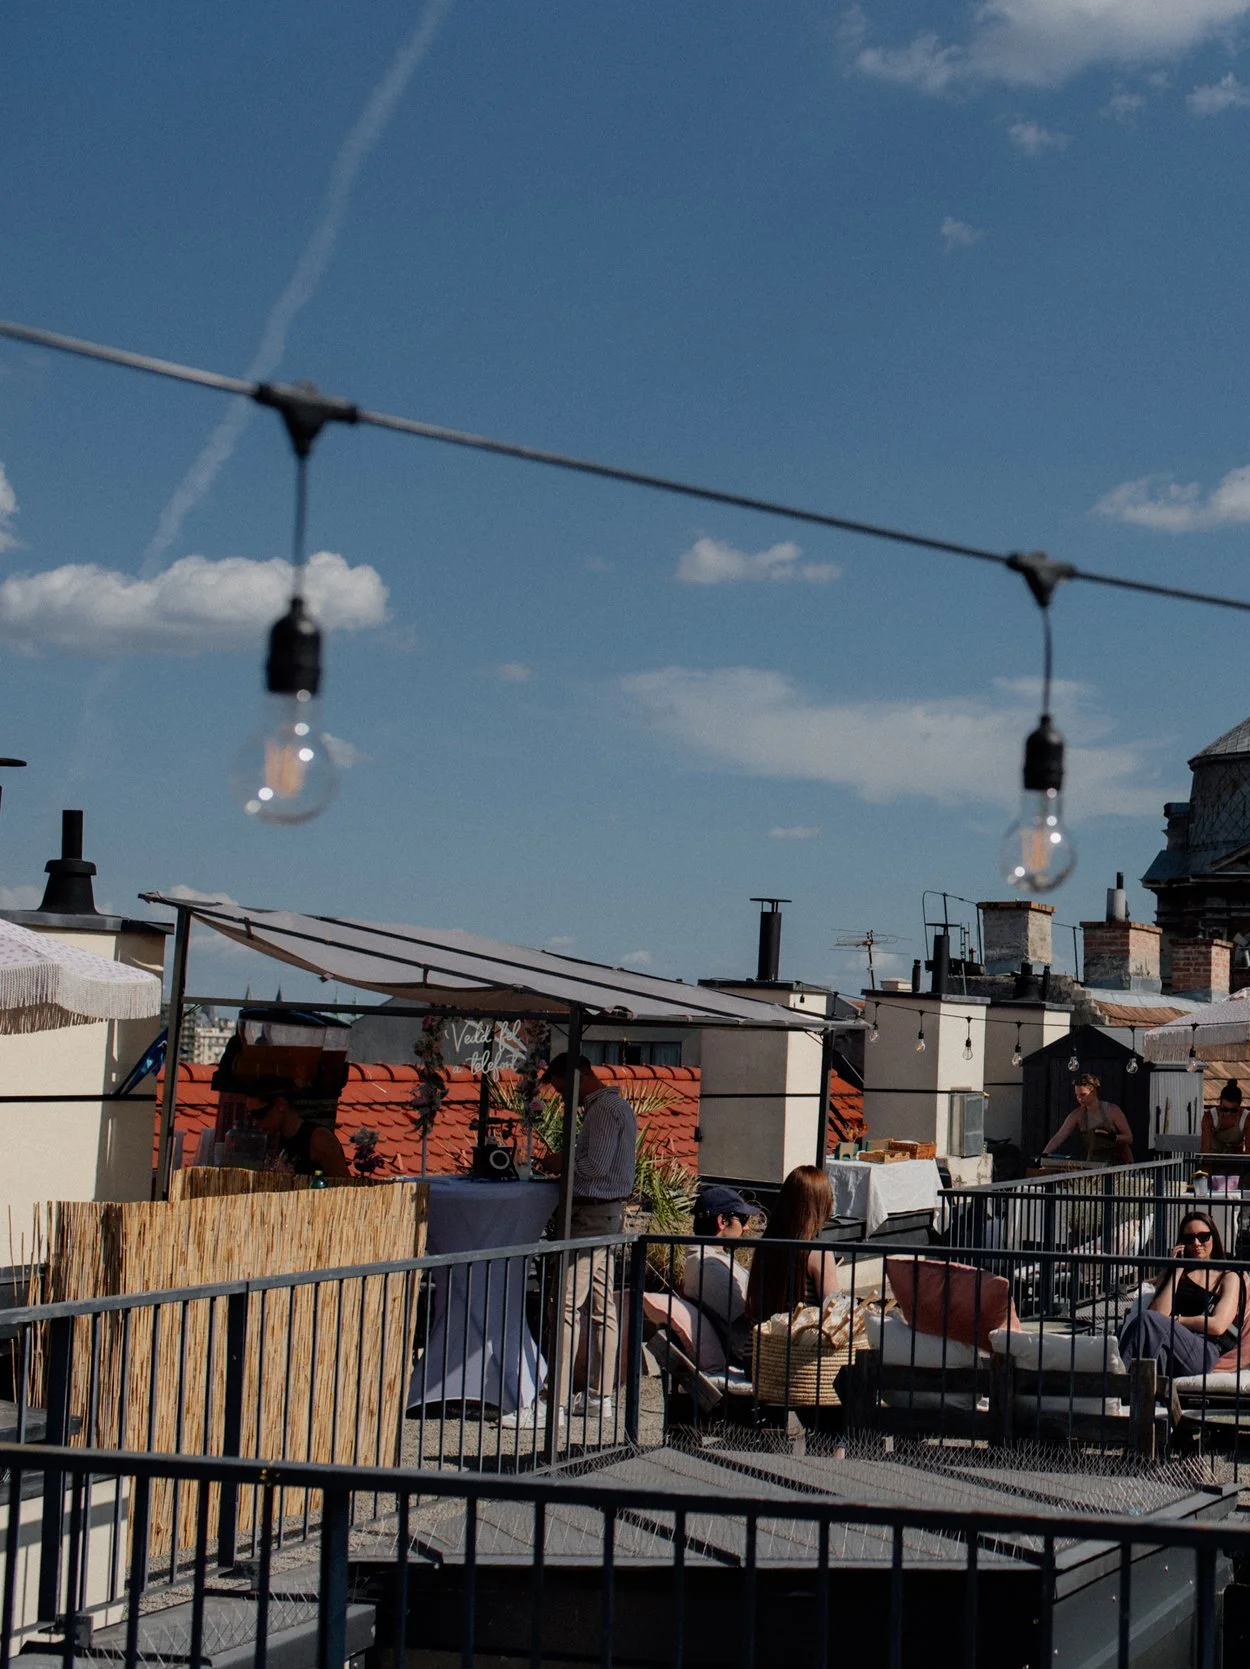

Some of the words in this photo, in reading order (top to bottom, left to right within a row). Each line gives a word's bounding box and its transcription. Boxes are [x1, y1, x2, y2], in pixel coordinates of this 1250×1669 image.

[444, 1021, 492, 1053] Vedd
[499, 1019, 521, 1052] fel
[452, 1065, 462, 1074] a
